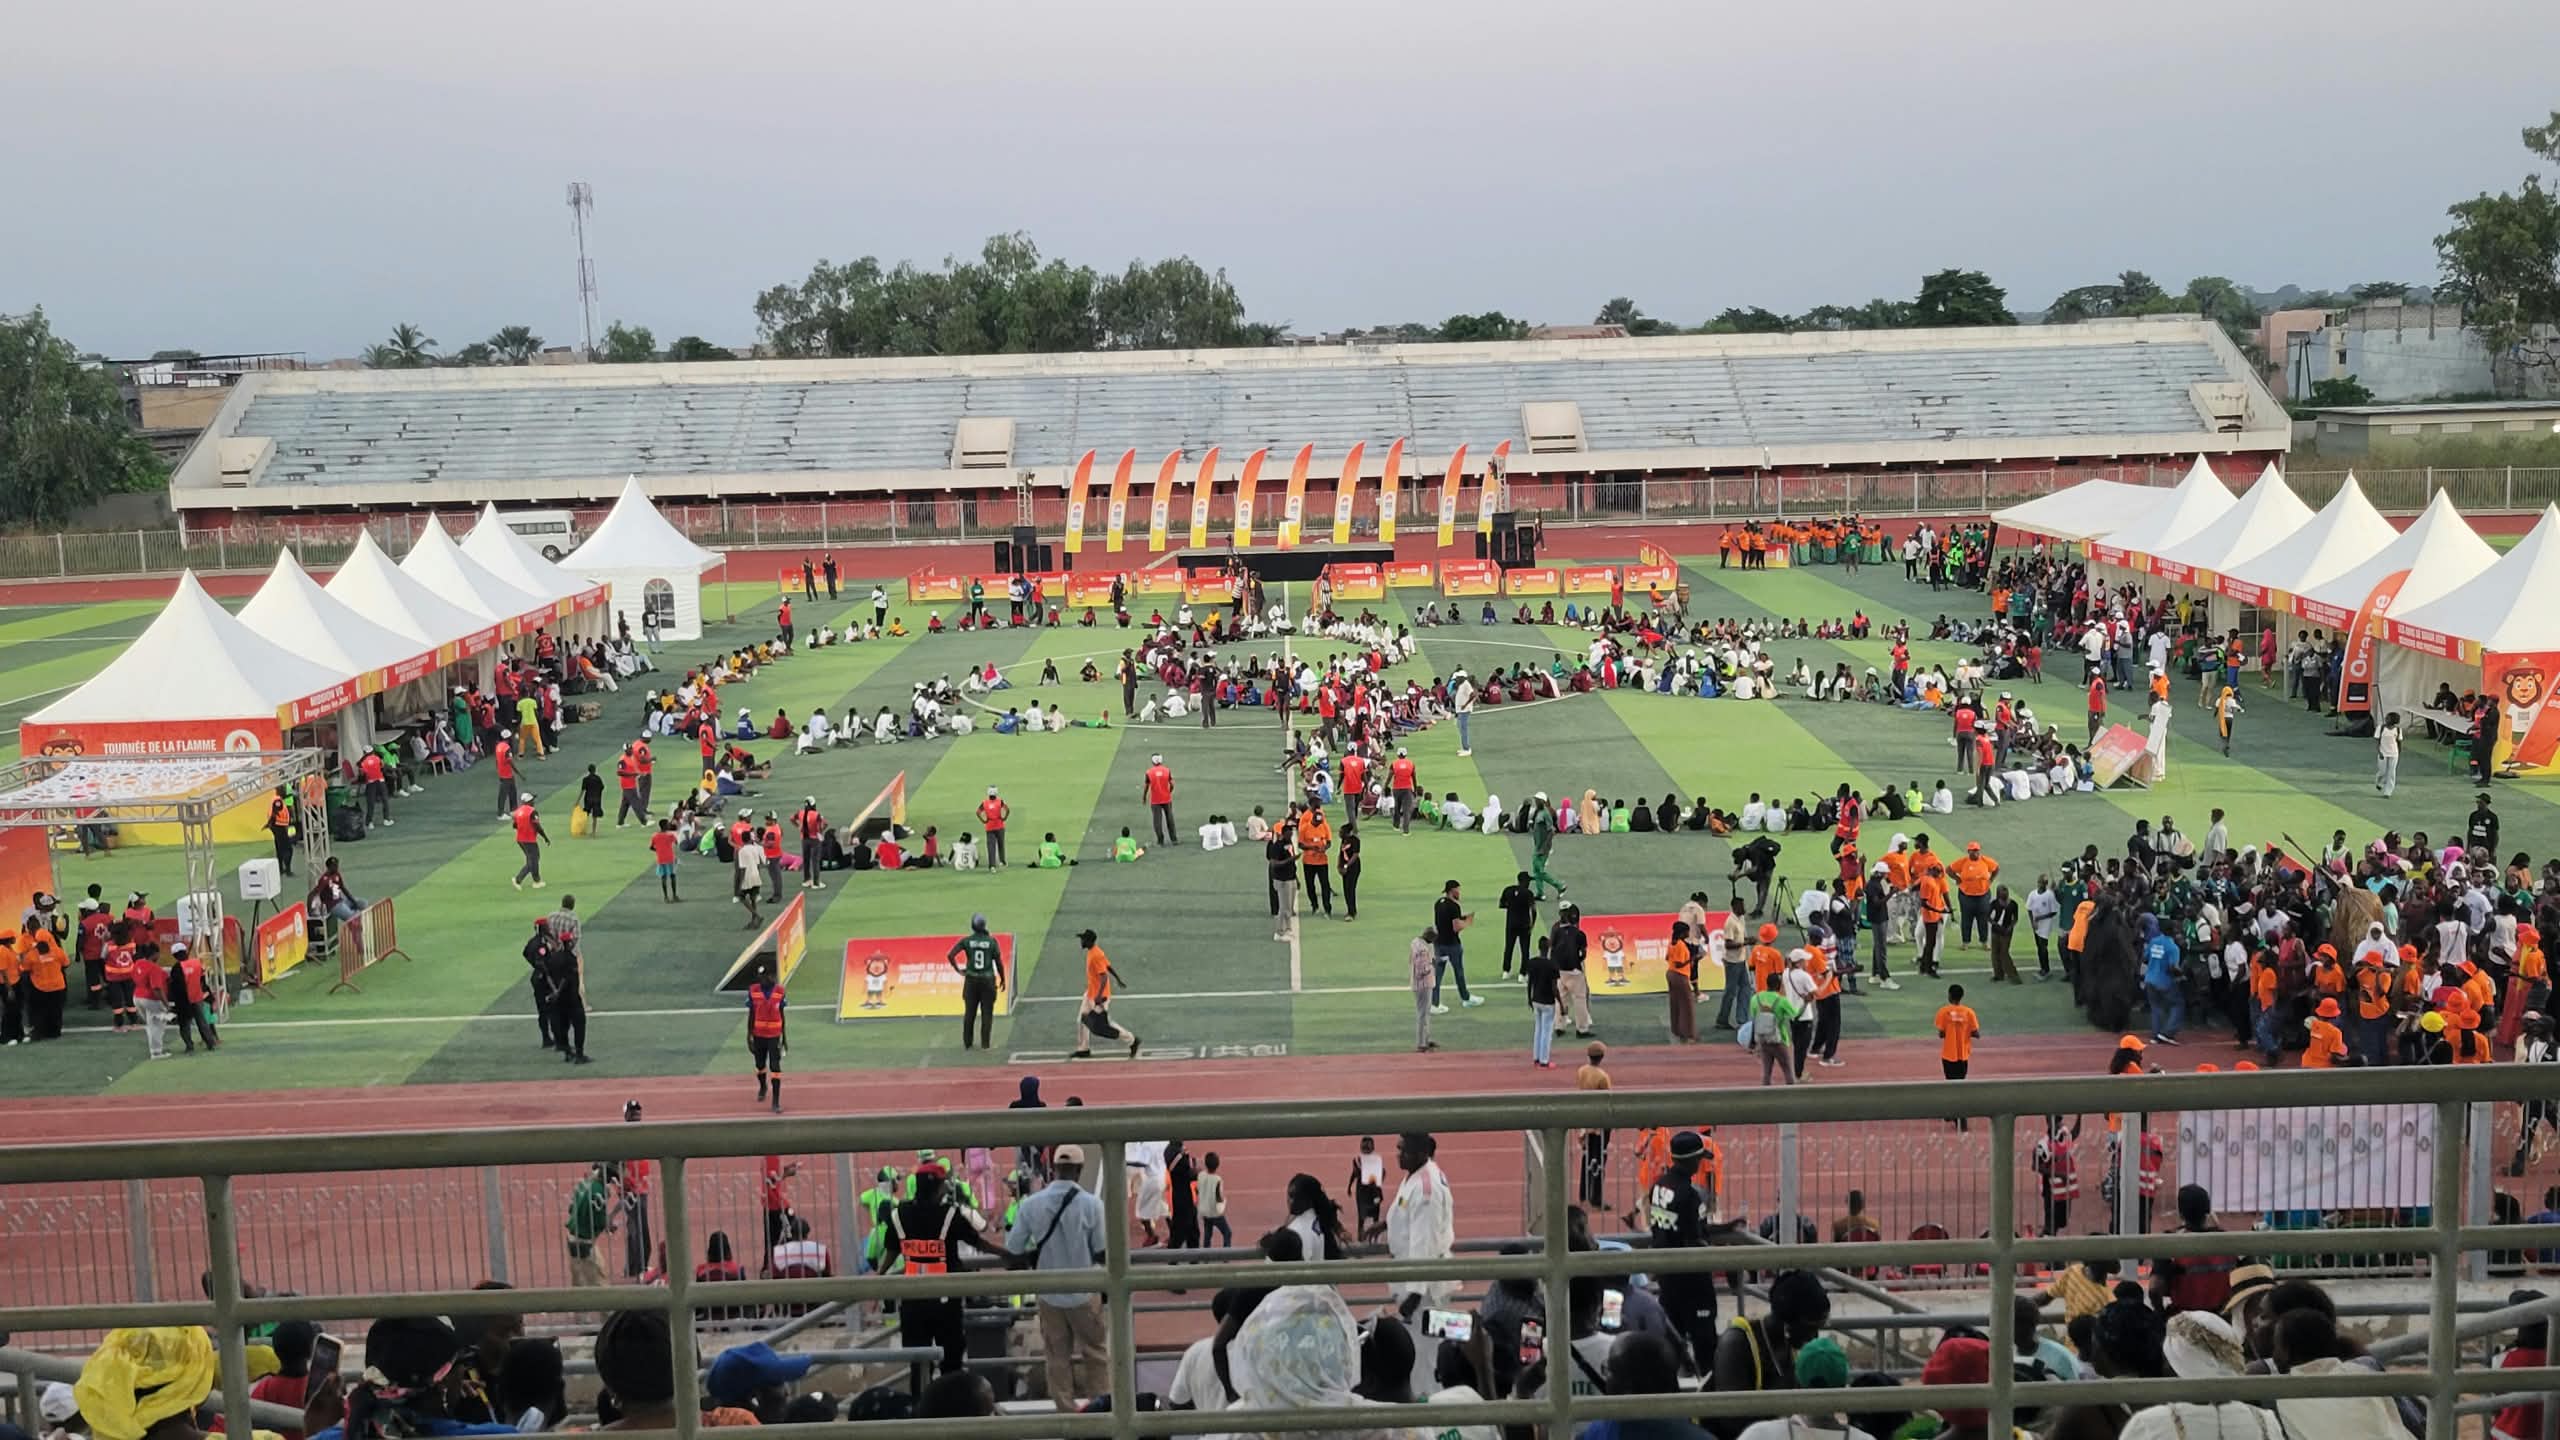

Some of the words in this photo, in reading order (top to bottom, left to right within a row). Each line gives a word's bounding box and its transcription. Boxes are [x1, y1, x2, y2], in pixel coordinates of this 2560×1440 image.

[103, 740, 146, 754] TOURNÉE
[148, 741, 161, 753] DE
[162, 740, 175, 752] LA
[176, 739, 217, 752] FLAMME
[974, 950, 985, 970] 9
[903, 1241, 945, 1254] POLICE
